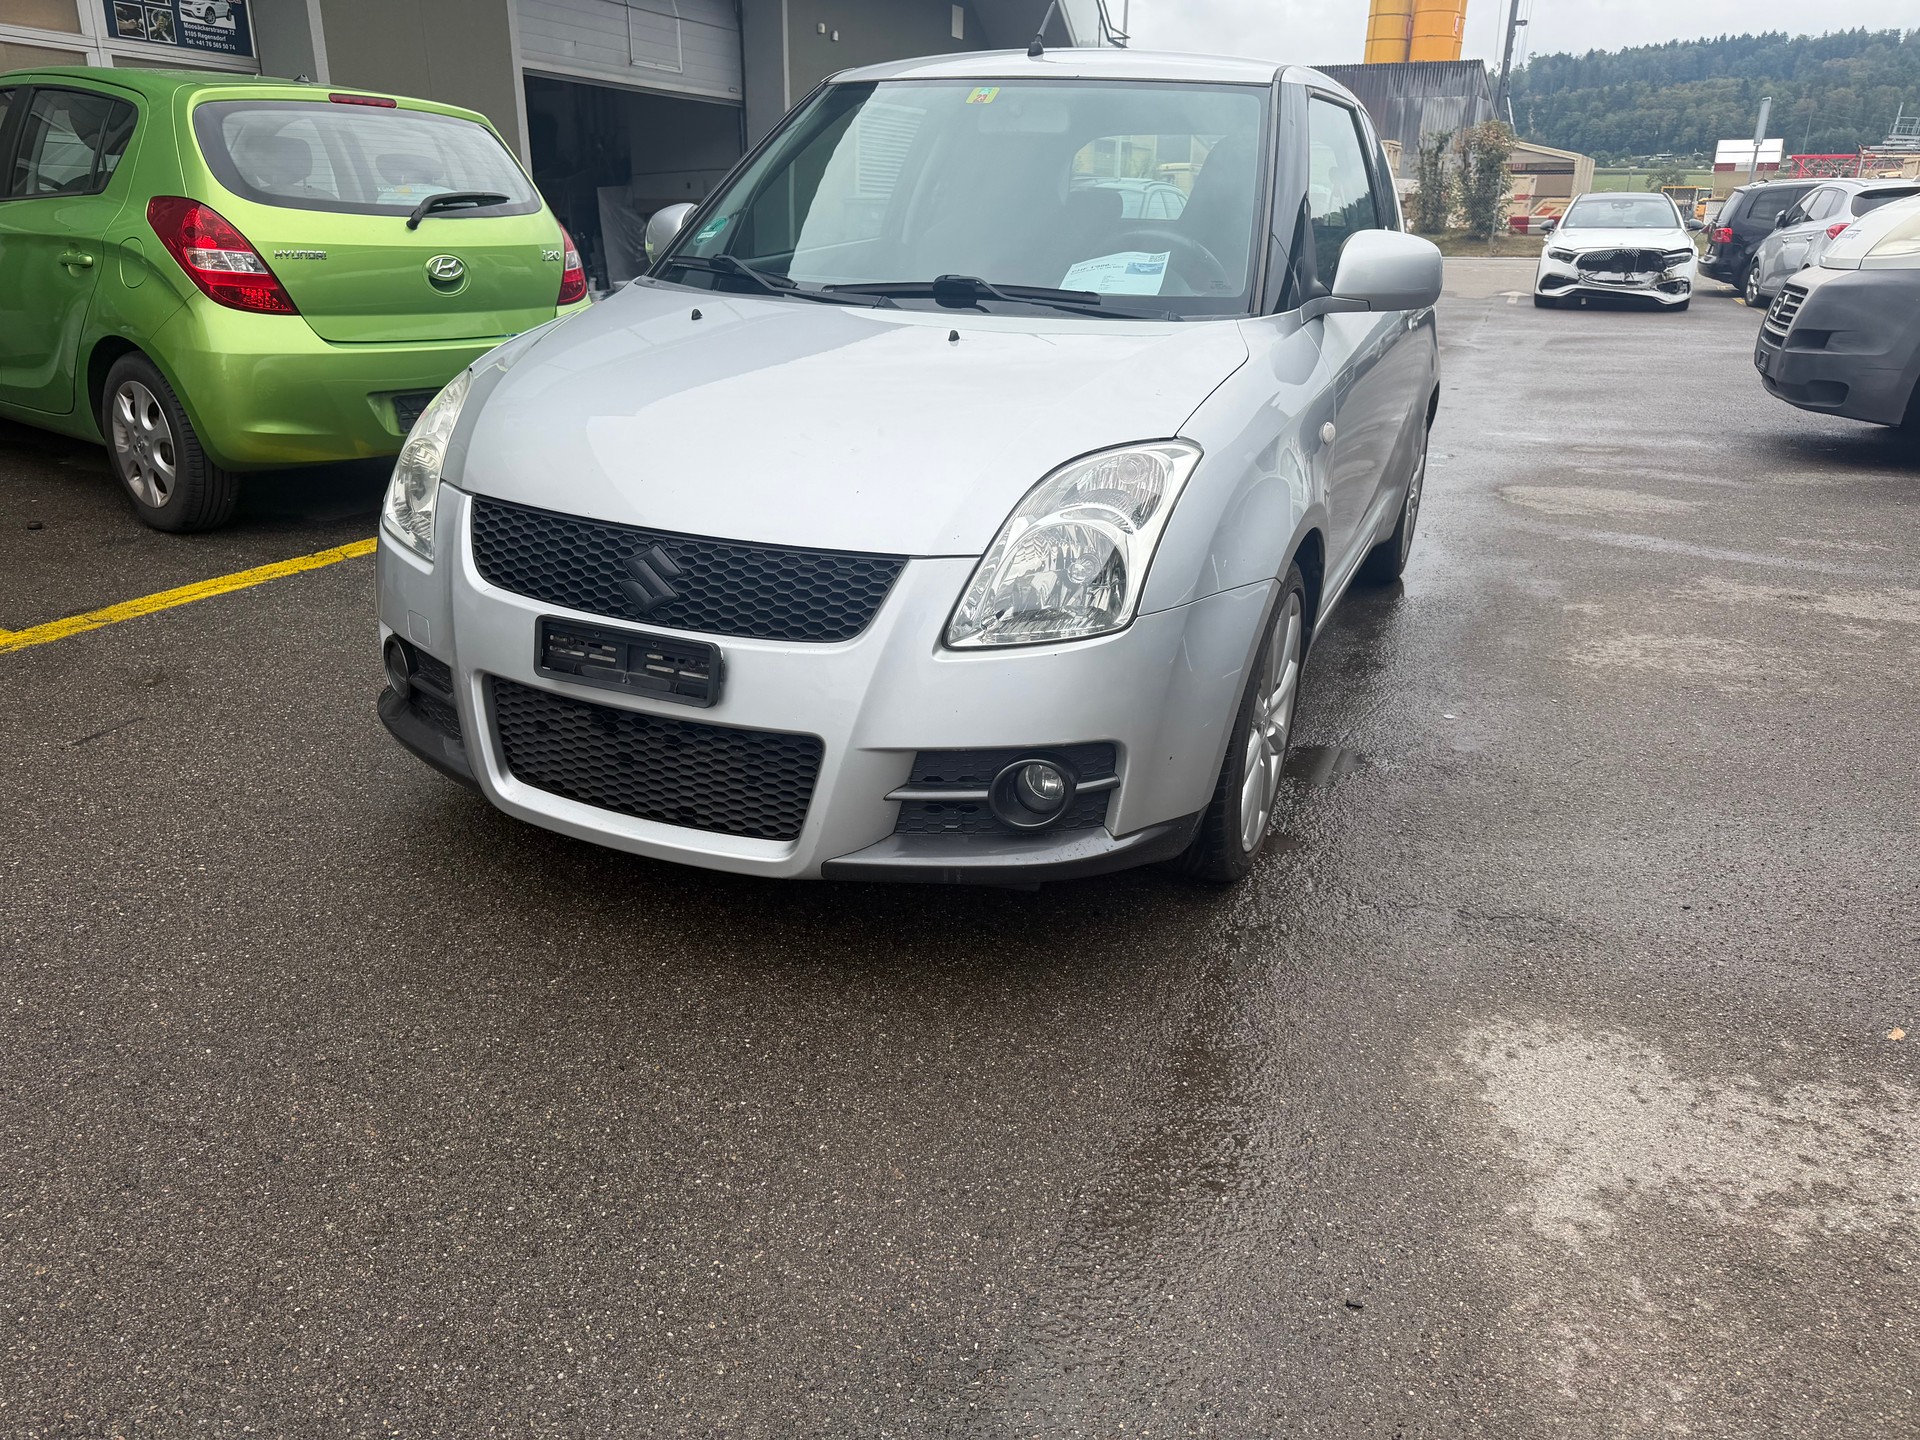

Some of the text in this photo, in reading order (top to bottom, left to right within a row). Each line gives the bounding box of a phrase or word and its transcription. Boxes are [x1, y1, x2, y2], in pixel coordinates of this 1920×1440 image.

[183, 22, 228, 35] Moosäckerstrasse
[184, 30, 227, 42] 8105 Regensdorf
[185, 37, 195, 45] Tel.
[273, 249, 327, 261] HYUNDAI
[542, 249, 561, 262] i20
